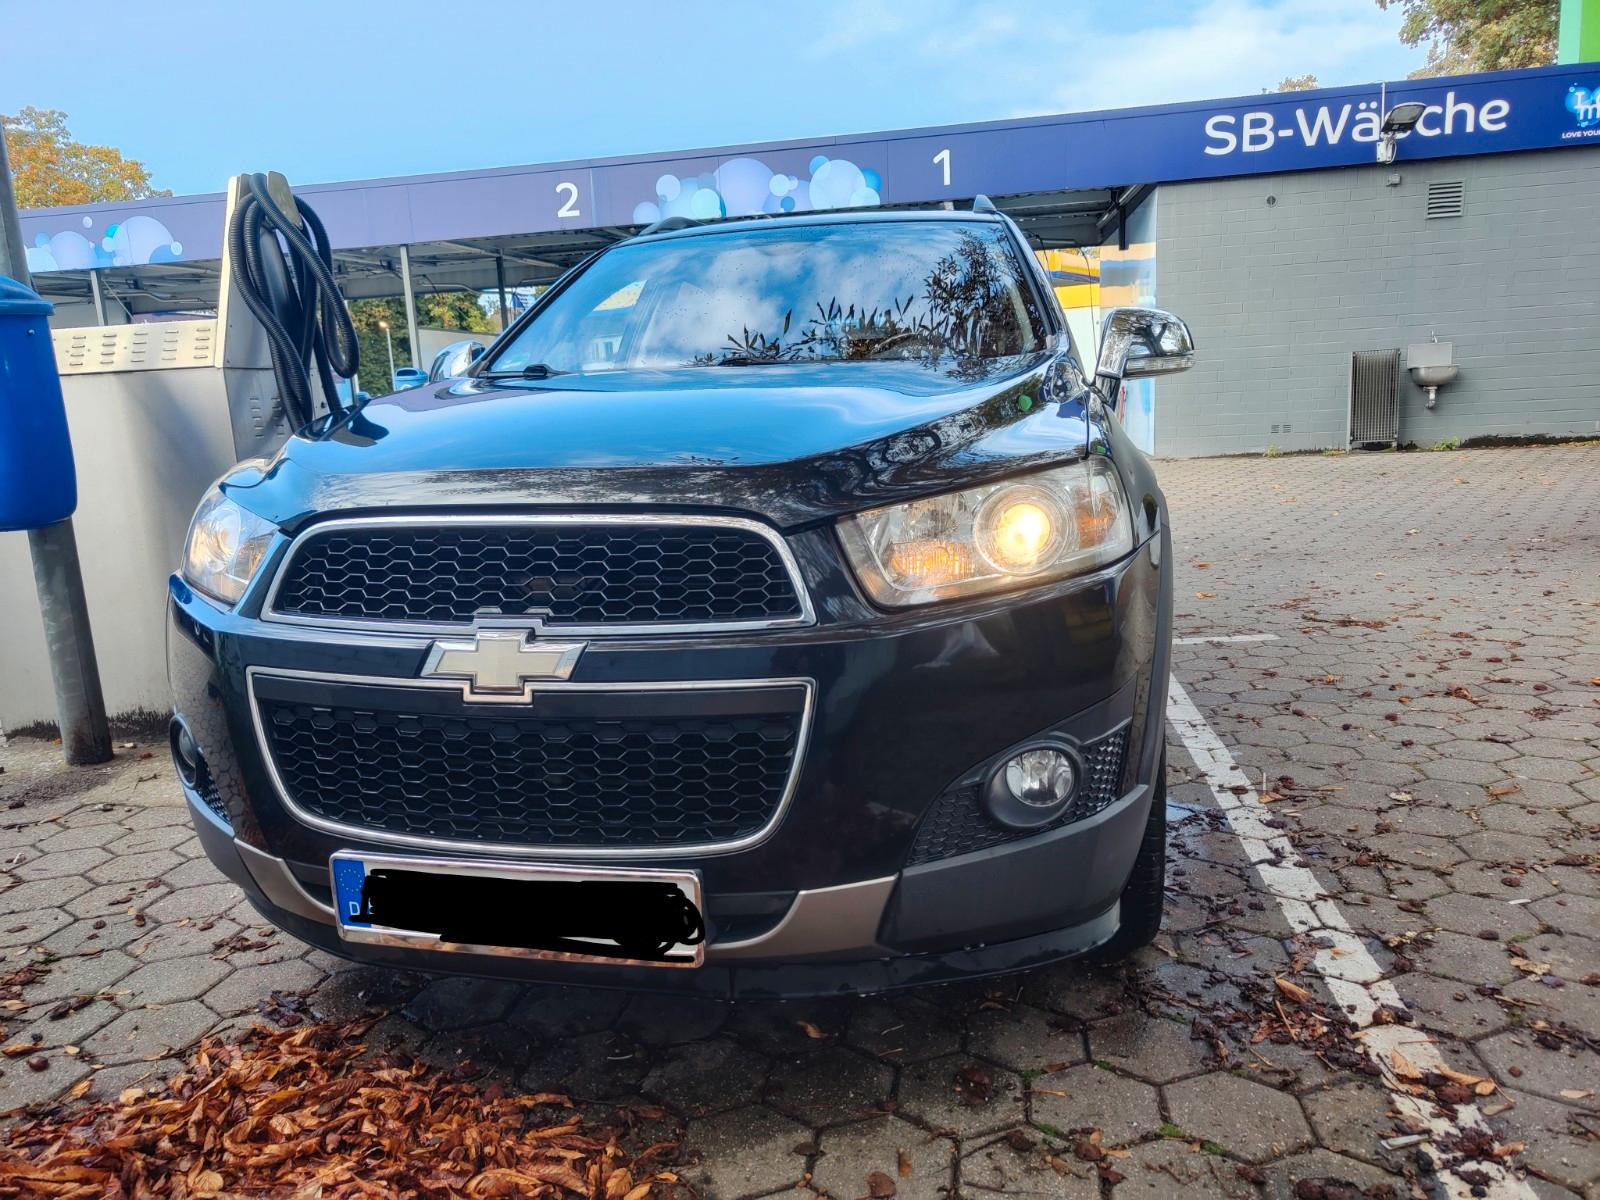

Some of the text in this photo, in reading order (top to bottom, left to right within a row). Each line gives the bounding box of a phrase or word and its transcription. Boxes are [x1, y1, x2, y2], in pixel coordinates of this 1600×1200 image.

[1562, 131, 1582, 139] LOVE
[932, 149, 951, 186] 1
[555, 182, 580, 218] 2
[348, 901, 361, 916] D
